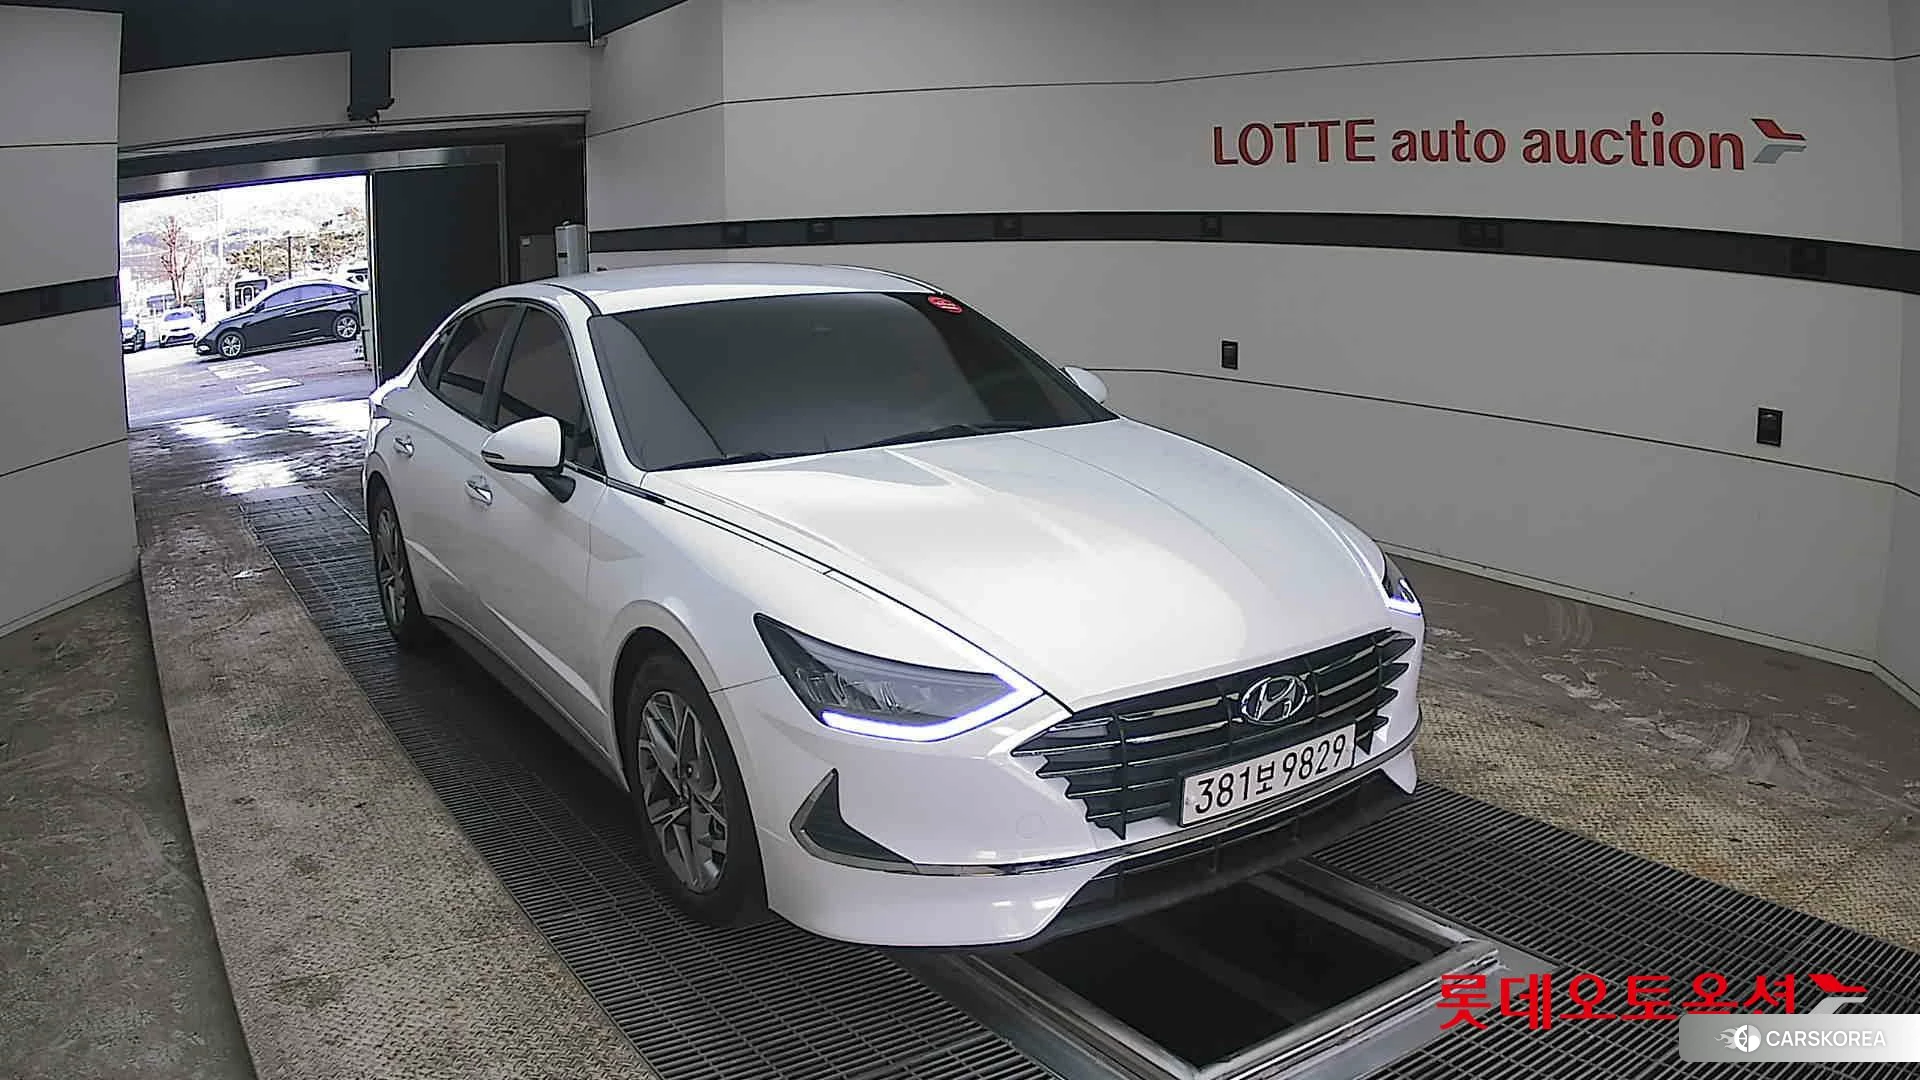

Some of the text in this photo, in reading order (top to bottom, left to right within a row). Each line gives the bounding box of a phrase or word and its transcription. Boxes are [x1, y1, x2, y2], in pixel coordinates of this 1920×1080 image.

[1213, 111, 1745, 170] LOTTE auto auction
